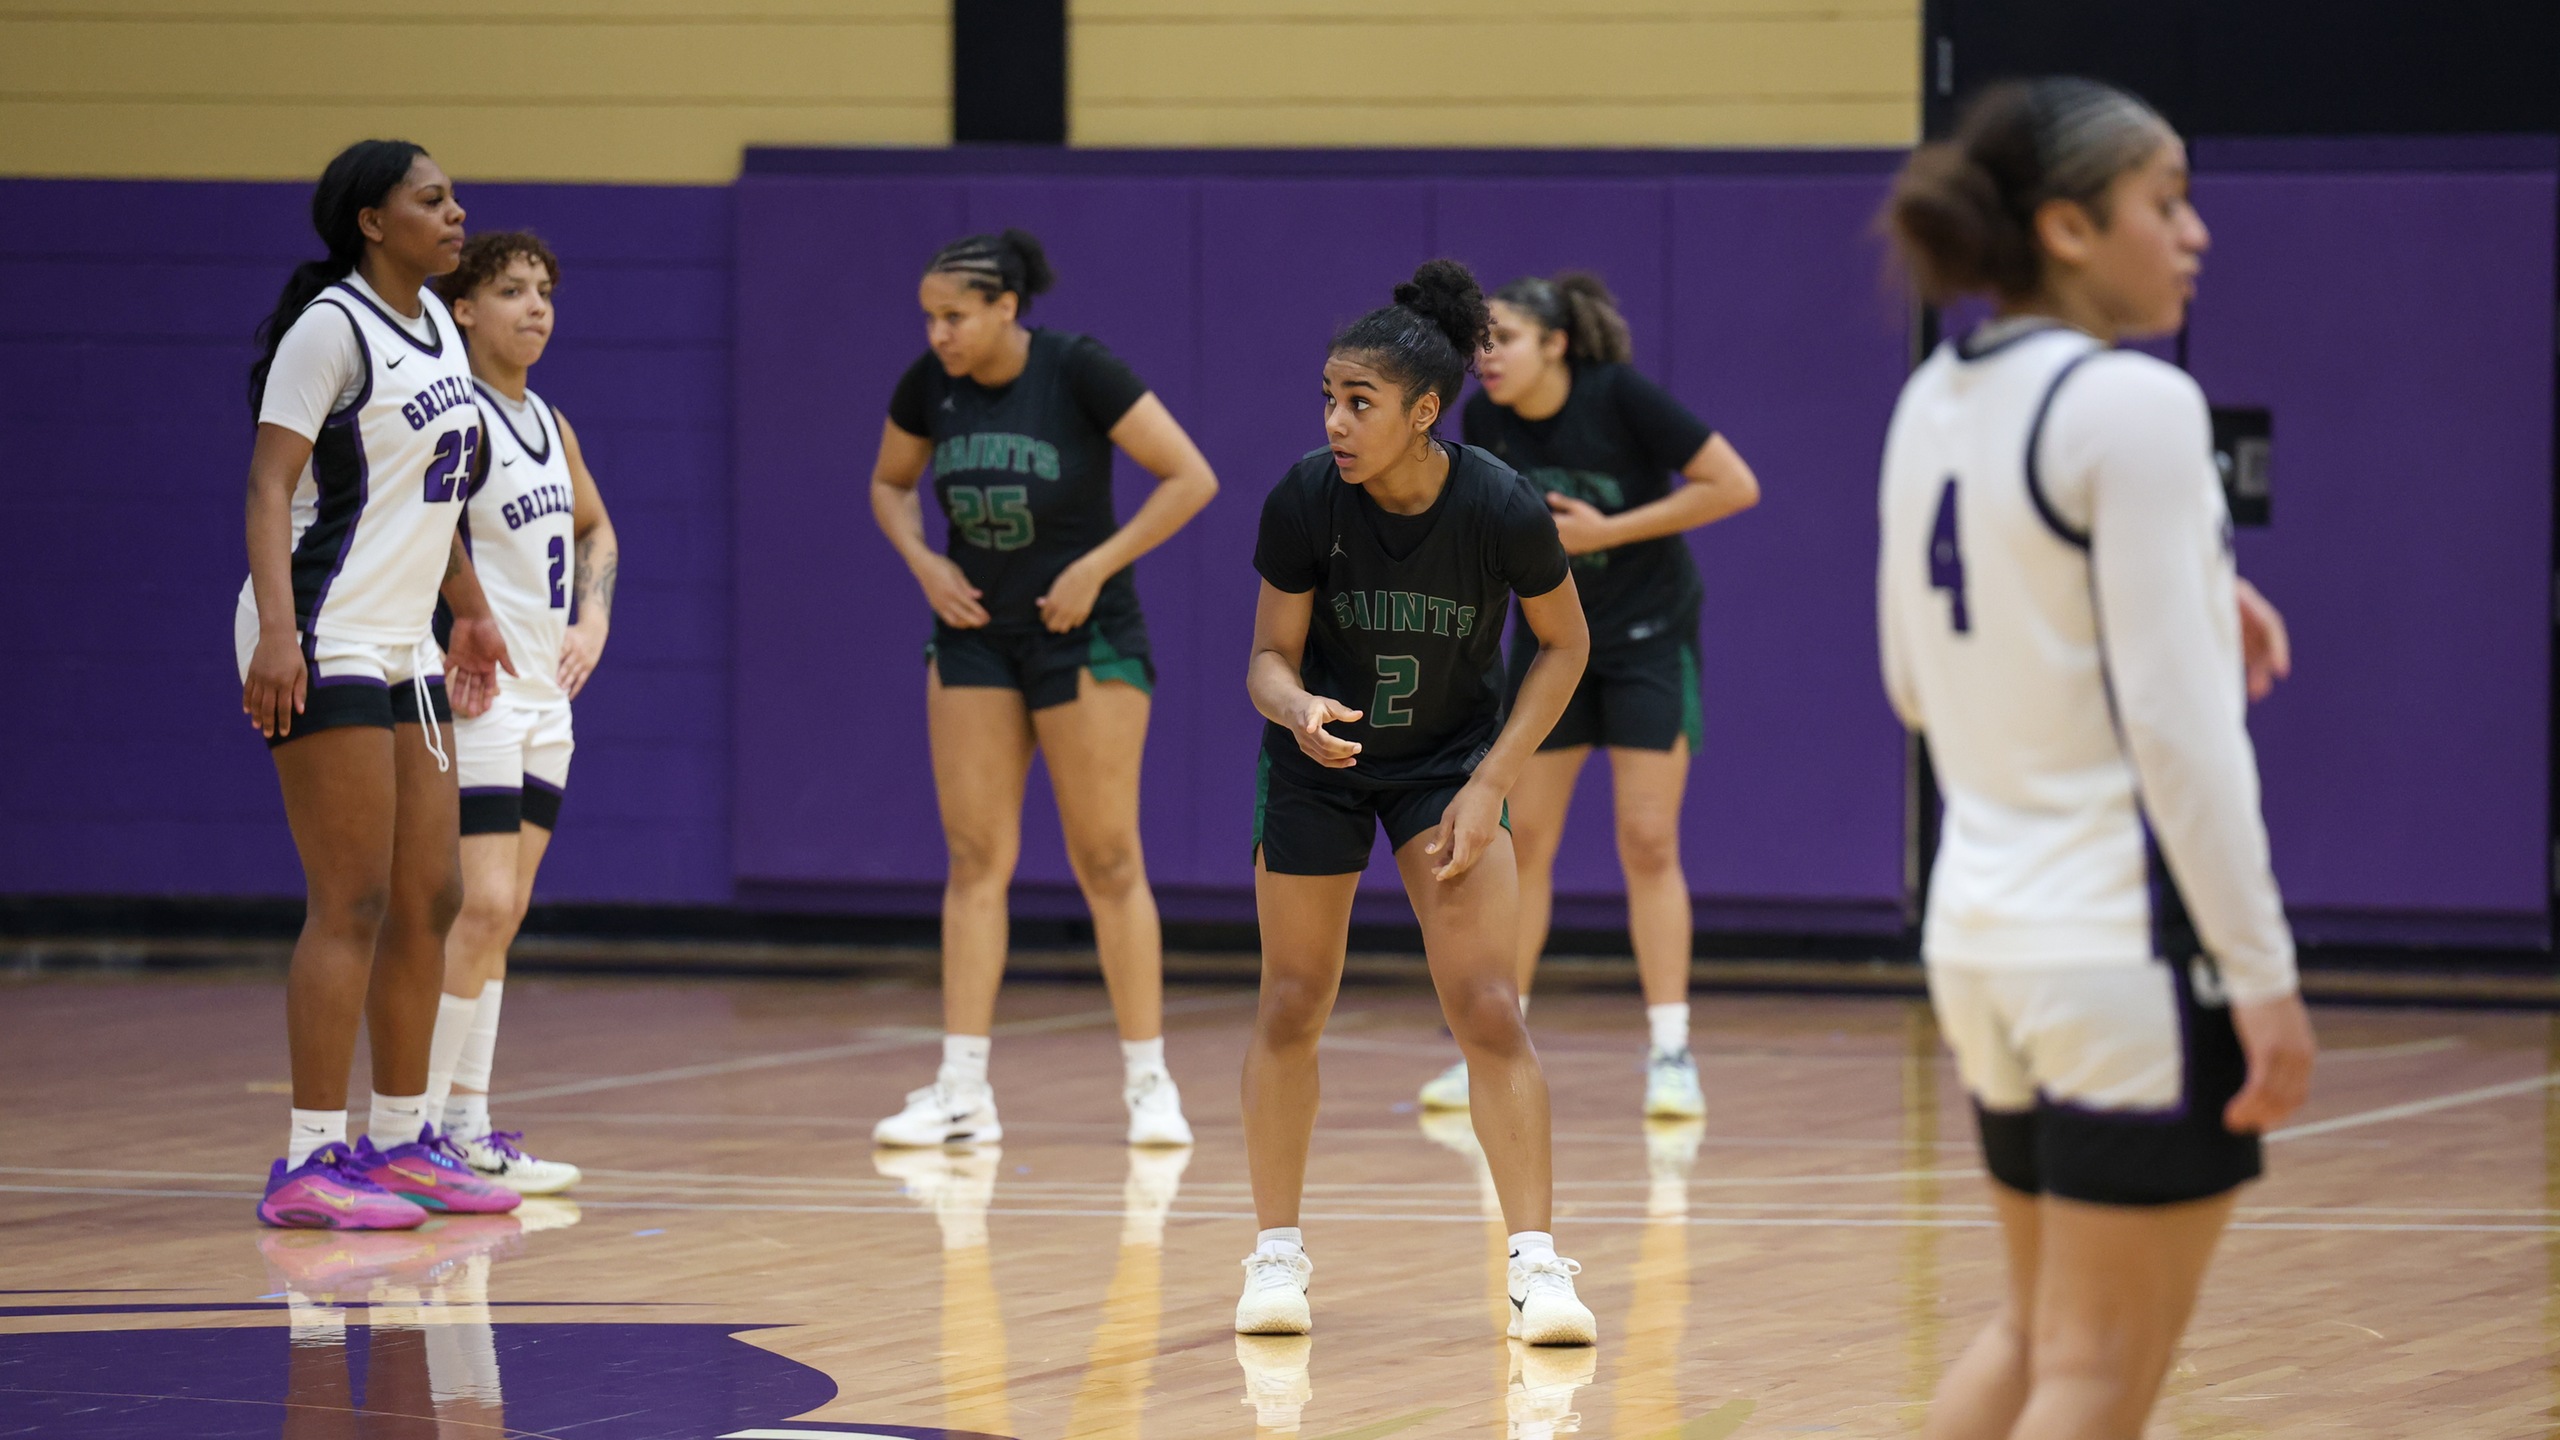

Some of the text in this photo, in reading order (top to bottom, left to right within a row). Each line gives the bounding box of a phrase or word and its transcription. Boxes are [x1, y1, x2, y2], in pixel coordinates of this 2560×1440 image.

[423, 425, 478, 503] 23
[934, 432, 1060, 482] SAINTS
[501, 484, 574, 531] GRIZZL
[946, 485, 1035, 551] 25
[547, 535, 565, 609] 2
[1930, 474, 1971, 634] 4
[1331, 589, 1477, 639] SAINTS
[1369, 654, 1420, 728] 2
